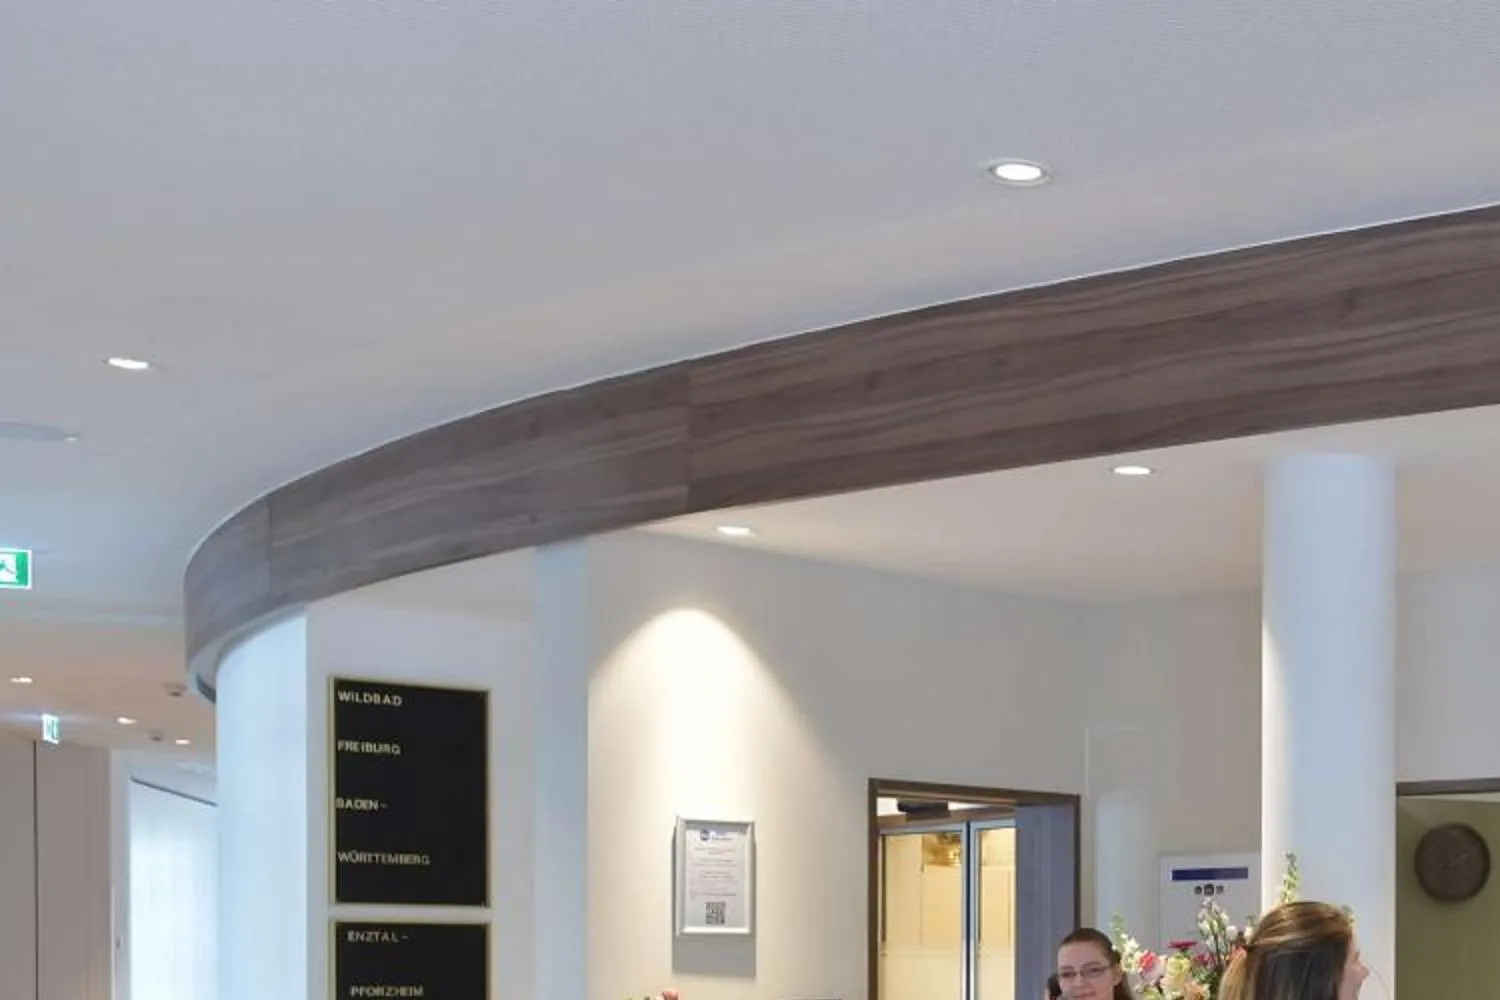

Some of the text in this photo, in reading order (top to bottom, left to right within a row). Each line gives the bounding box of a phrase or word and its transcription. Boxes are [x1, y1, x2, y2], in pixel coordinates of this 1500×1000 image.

[337, 690, 403, 706] WILDBAD
[337, 739, 402, 756] FREIBURG
[350, 984, 425, 998] PFORZHEIM
